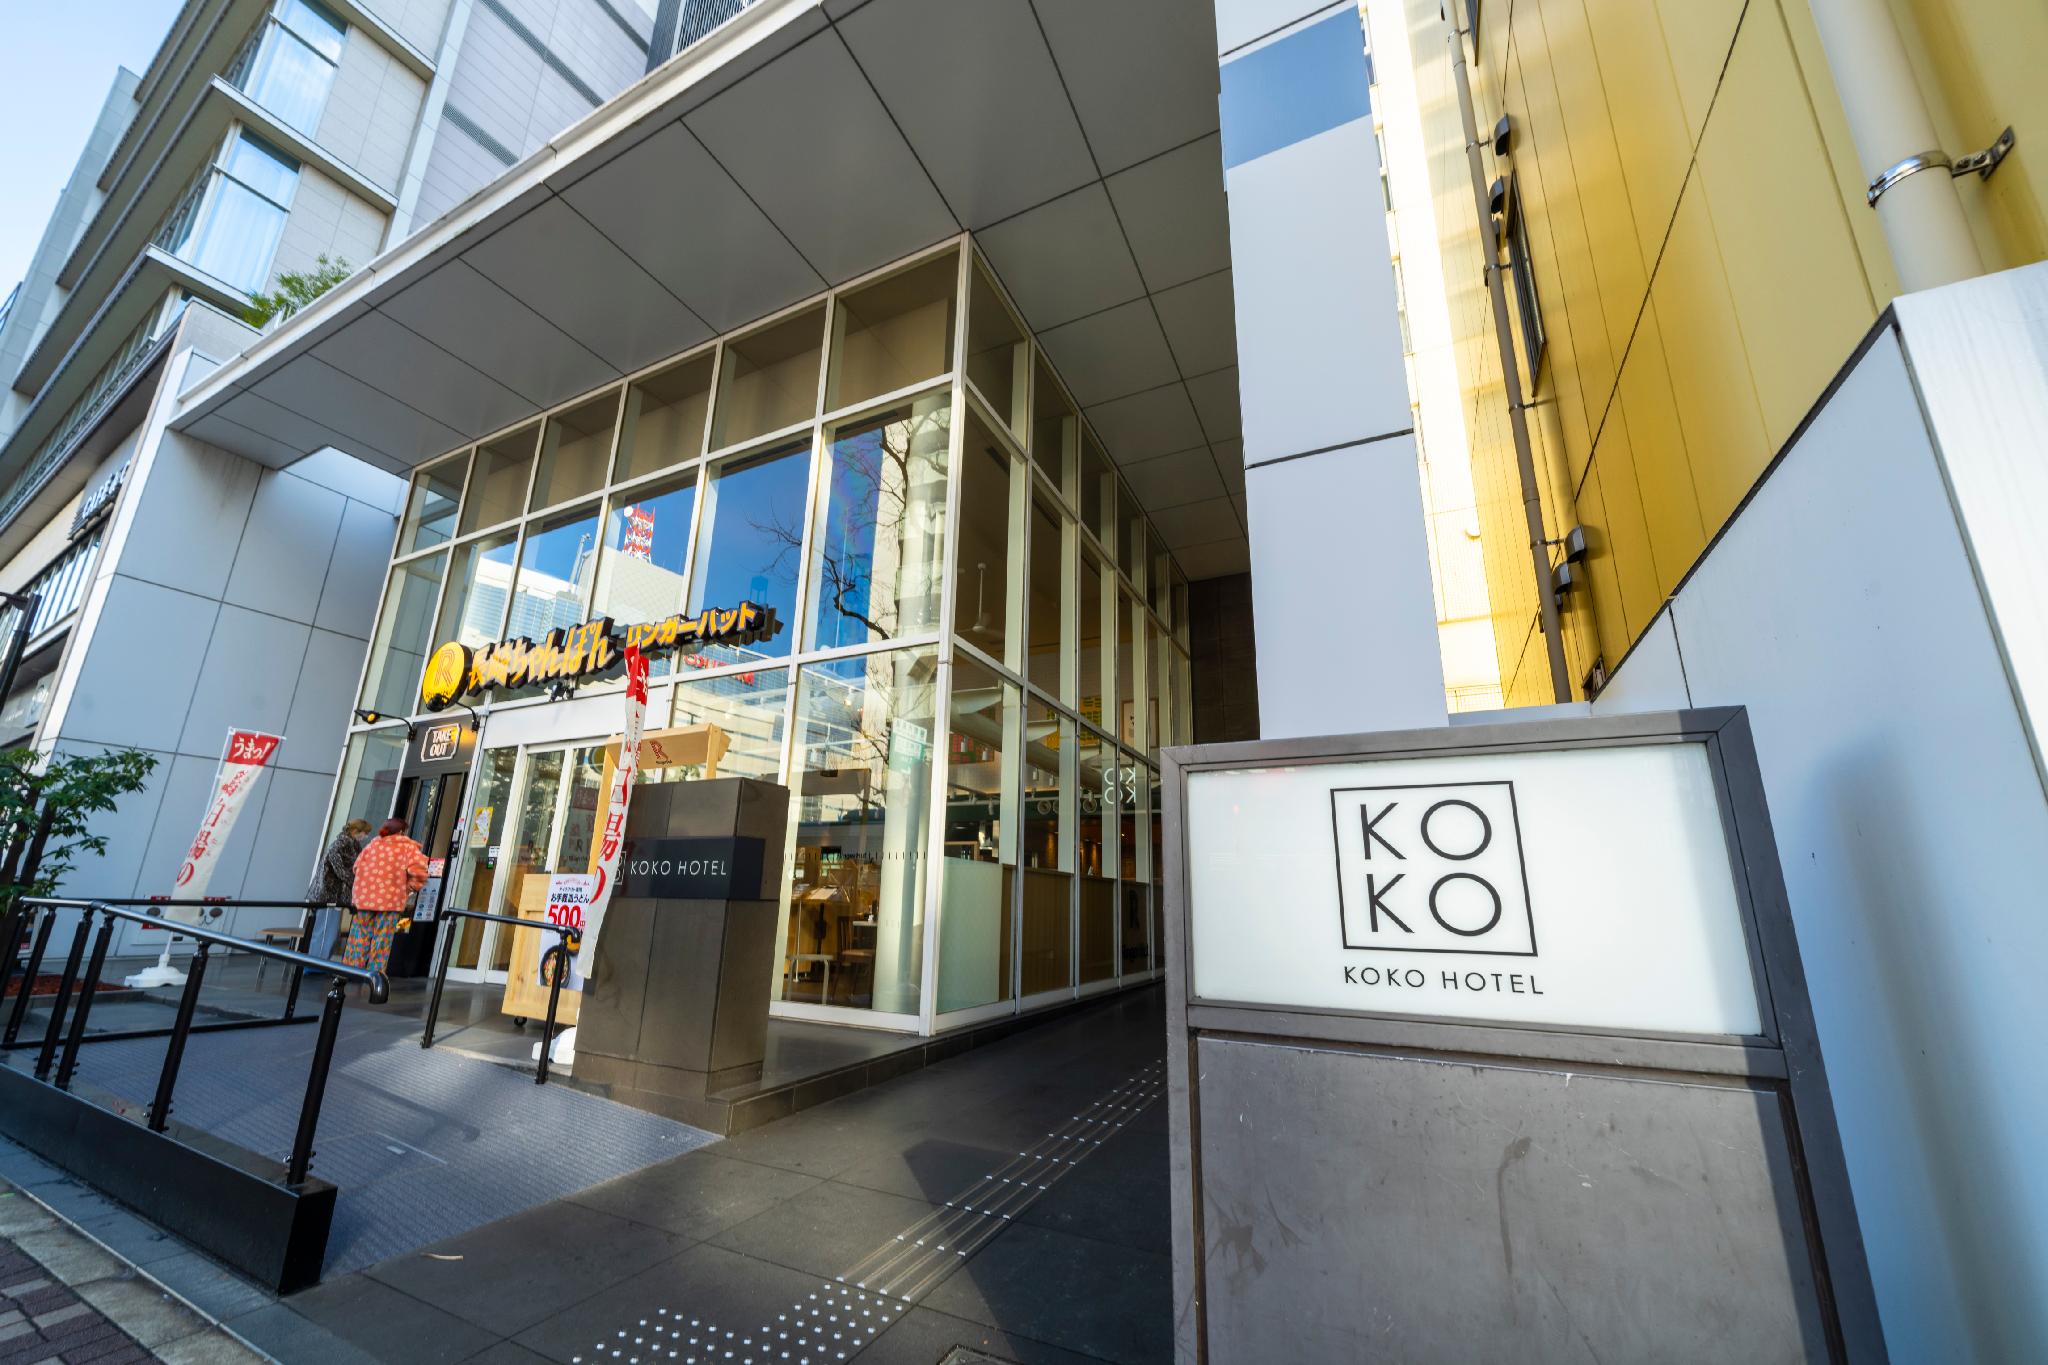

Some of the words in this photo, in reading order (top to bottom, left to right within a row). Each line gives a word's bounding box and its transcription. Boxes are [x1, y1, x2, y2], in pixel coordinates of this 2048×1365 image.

[626, 602, 756, 648] リンガーハット
[430, 742, 449, 757] OUT
[432, 729, 453, 744] TAKE
[1360, 799, 1492, 861] KO
[630, 860, 671, 876] KOKO
[677, 860, 727, 876] HOTEL
[1366, 872, 1502, 937] KO
[1344, 965, 1425, 988] KOKO
[1441, 970, 1544, 995] HOTEL
